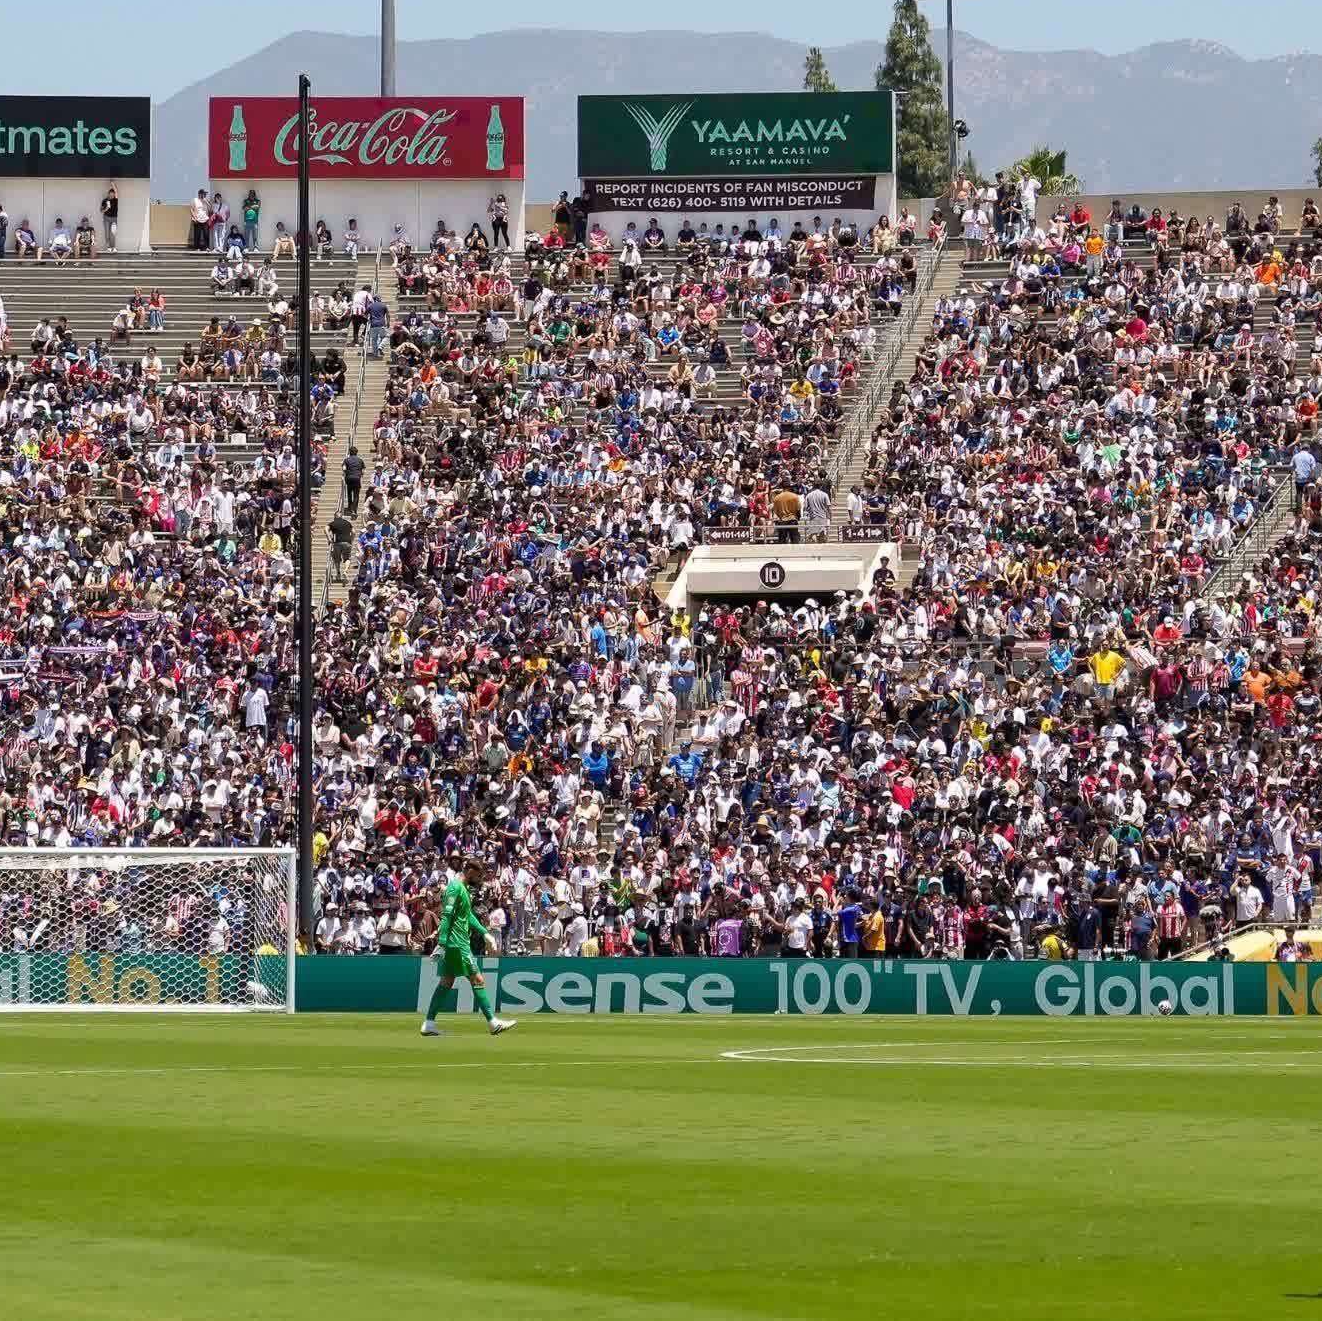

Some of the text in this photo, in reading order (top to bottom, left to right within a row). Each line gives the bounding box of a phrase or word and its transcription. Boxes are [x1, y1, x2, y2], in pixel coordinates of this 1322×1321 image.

[273, 107, 458, 166] Coca-Cola
[710, 146, 830, 156] RESORT & CASINO
[729, 158, 813, 166] AT SAN MANUEL
[595, 180, 863, 194] REPORT INCIDENTS OF FAN MISCONDUCT
[611, 194, 842, 209] TEXT (626) 400- 5119 WITH DETAILS
[719, 530, 750, 539] 101-141
[846, 529, 871, 538] 1-41
[764, 567, 780, 583] 10
[67, 953, 176, 1006] No.
[199, 953, 220, 1005] 1
[903, 963, 1001, 1017] TV,
[1034, 962, 1235, 1016] Global
